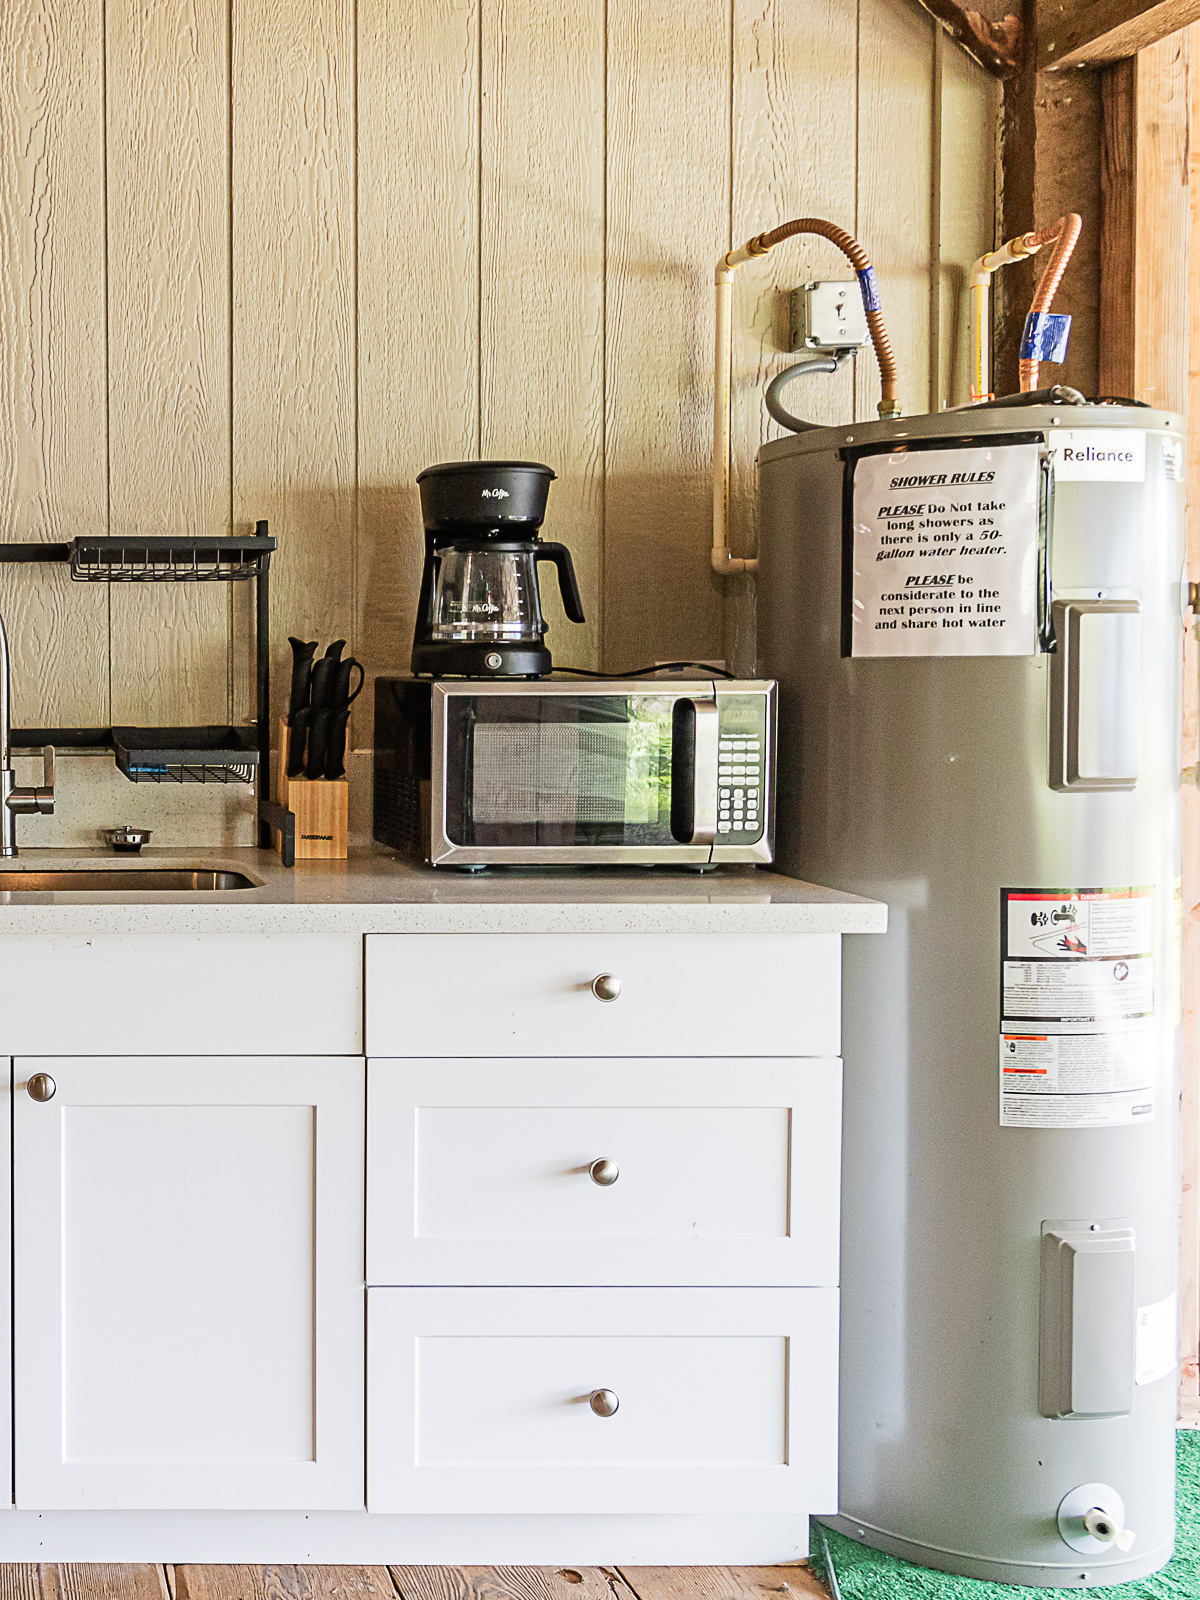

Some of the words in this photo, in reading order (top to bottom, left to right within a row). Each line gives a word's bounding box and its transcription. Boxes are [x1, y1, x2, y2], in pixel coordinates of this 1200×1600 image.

[1064, 447, 1133, 461] Reliance
[889, 474, 947, 488] SHOWER
[951, 472, 995, 483] RULES
[877, 504, 926, 517] PLEASE
[928, 504, 945, 513] Do
[950, 502, 972, 512] Not
[978, 501, 1006, 510] take
[887, 520, 914, 531] long
[919, 518, 973, 528] showers
[881, 535, 913, 544] there
[918, 533, 928, 542] is
[934, 532, 961, 543] only
[980, 530, 1002, 540] 50-
[876, 549, 914, 561] gallon
[920, 546, 956, 557] water
[960, 545, 1007, 555] heater.
[905, 575, 956, 586] PLEASE
[958, 575, 973, 584] be
[881, 591, 955, 601] considerate
[961, 590, 973, 598] to
[979, 589, 999, 598] the
[880, 606, 904, 615] next
[909, 605, 953, 616] person
[959, 604, 971, 612] in
[977, 603, 1001, 612] line
[875, 620, 897, 629] and
[901, 619, 937, 629] share
[943, 619, 963, 627] hot
[969, 619, 1005, 627] water
